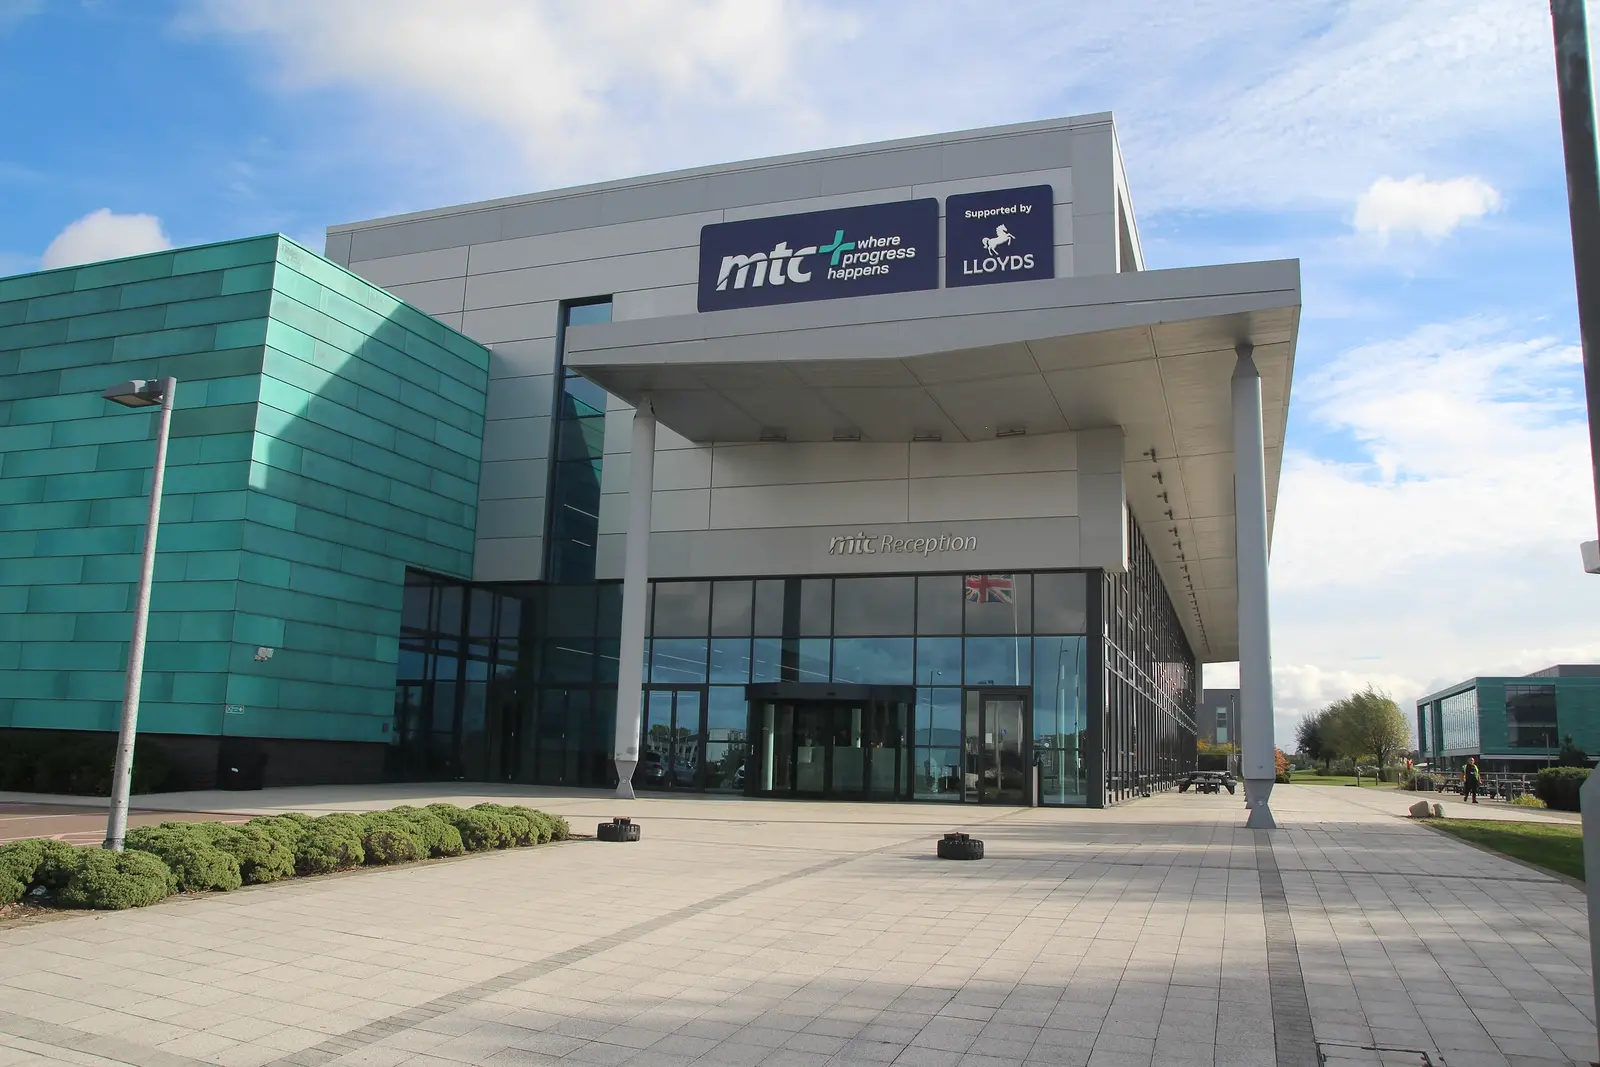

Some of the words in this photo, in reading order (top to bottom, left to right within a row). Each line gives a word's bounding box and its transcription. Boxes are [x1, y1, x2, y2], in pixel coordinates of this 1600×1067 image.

[964, 204, 1018, 219] Supported
[1020, 203, 1033, 217] by
[857, 234, 901, 250] where
[715, 241, 817, 291] mtc
[842, 246, 916, 268] progress
[963, 253, 1035, 275] LLOYDS
[827, 263, 890, 281] happens
[829, 531, 879, 555] mtc
[881, 532, 977, 557] Reception
